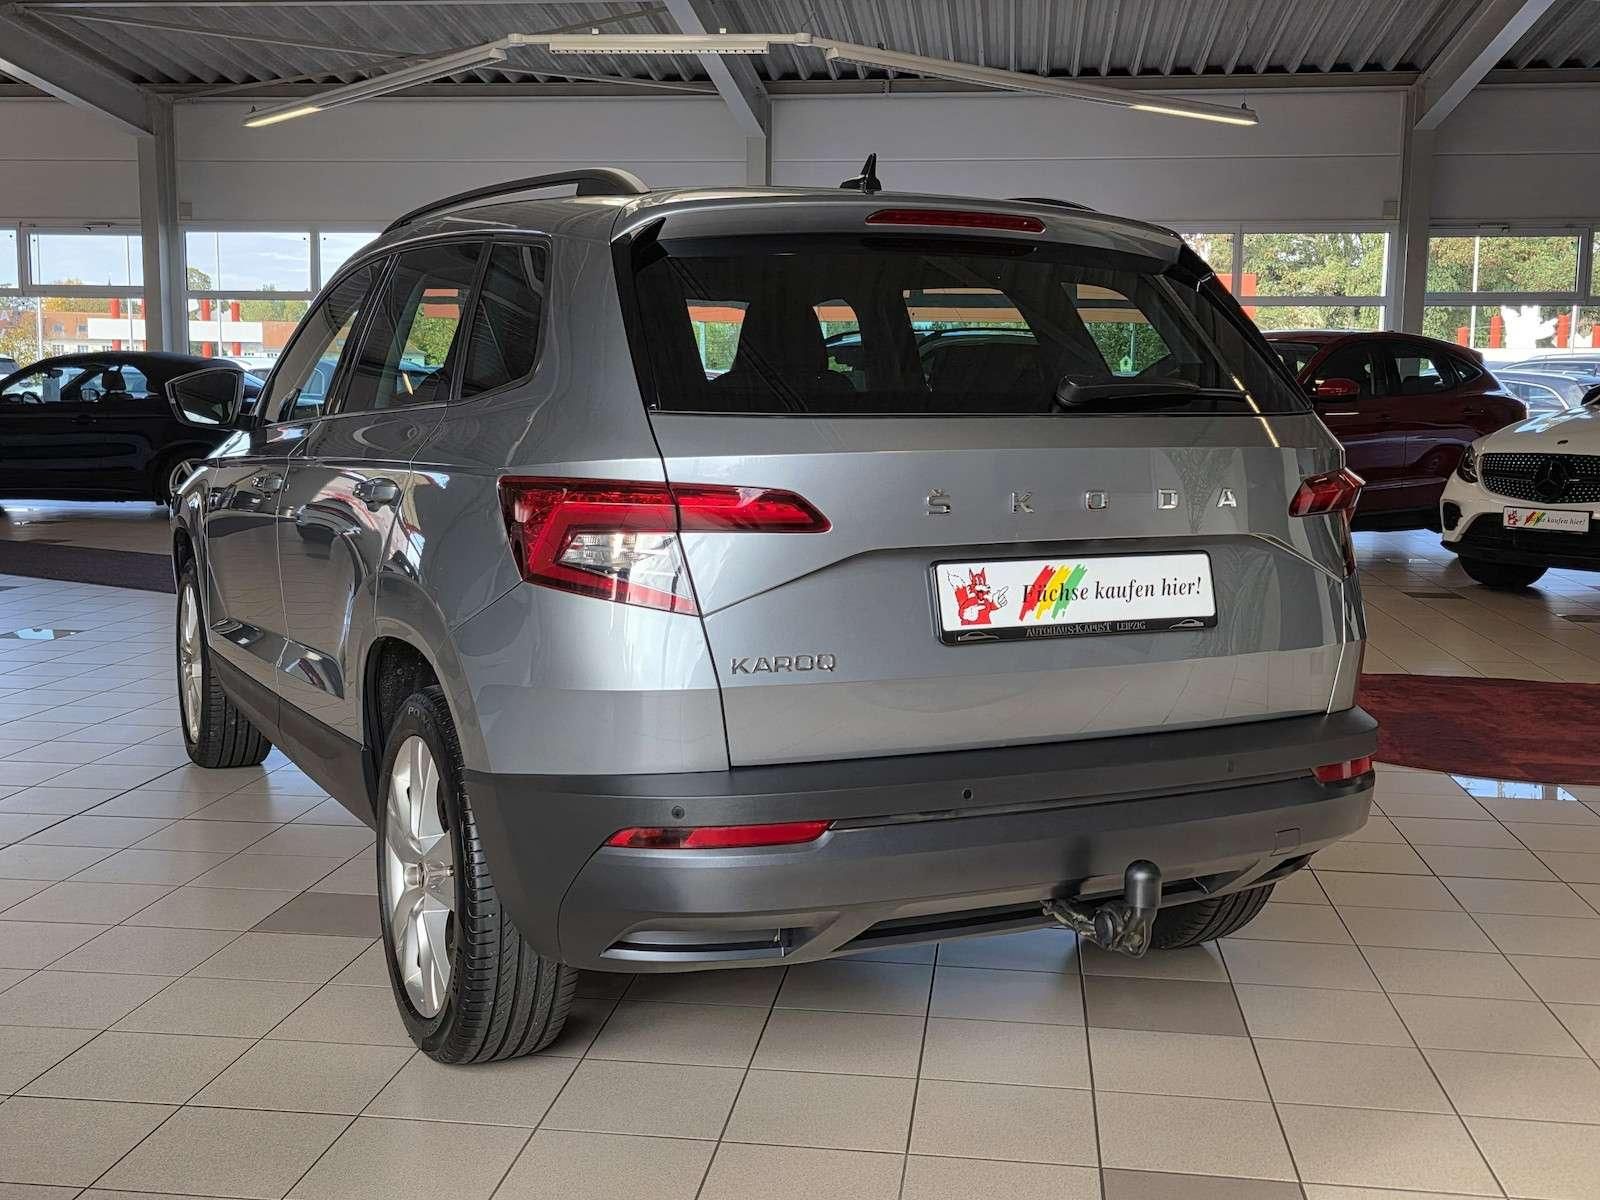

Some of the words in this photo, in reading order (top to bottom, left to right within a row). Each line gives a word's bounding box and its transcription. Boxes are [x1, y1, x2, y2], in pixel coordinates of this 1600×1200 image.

[1022, 584, 1089, 603] Füchse
[1096, 579, 1155, 602] kaufen
[1161, 576, 1202, 596] hier!
[731, 653, 836, 675] KAROQ
